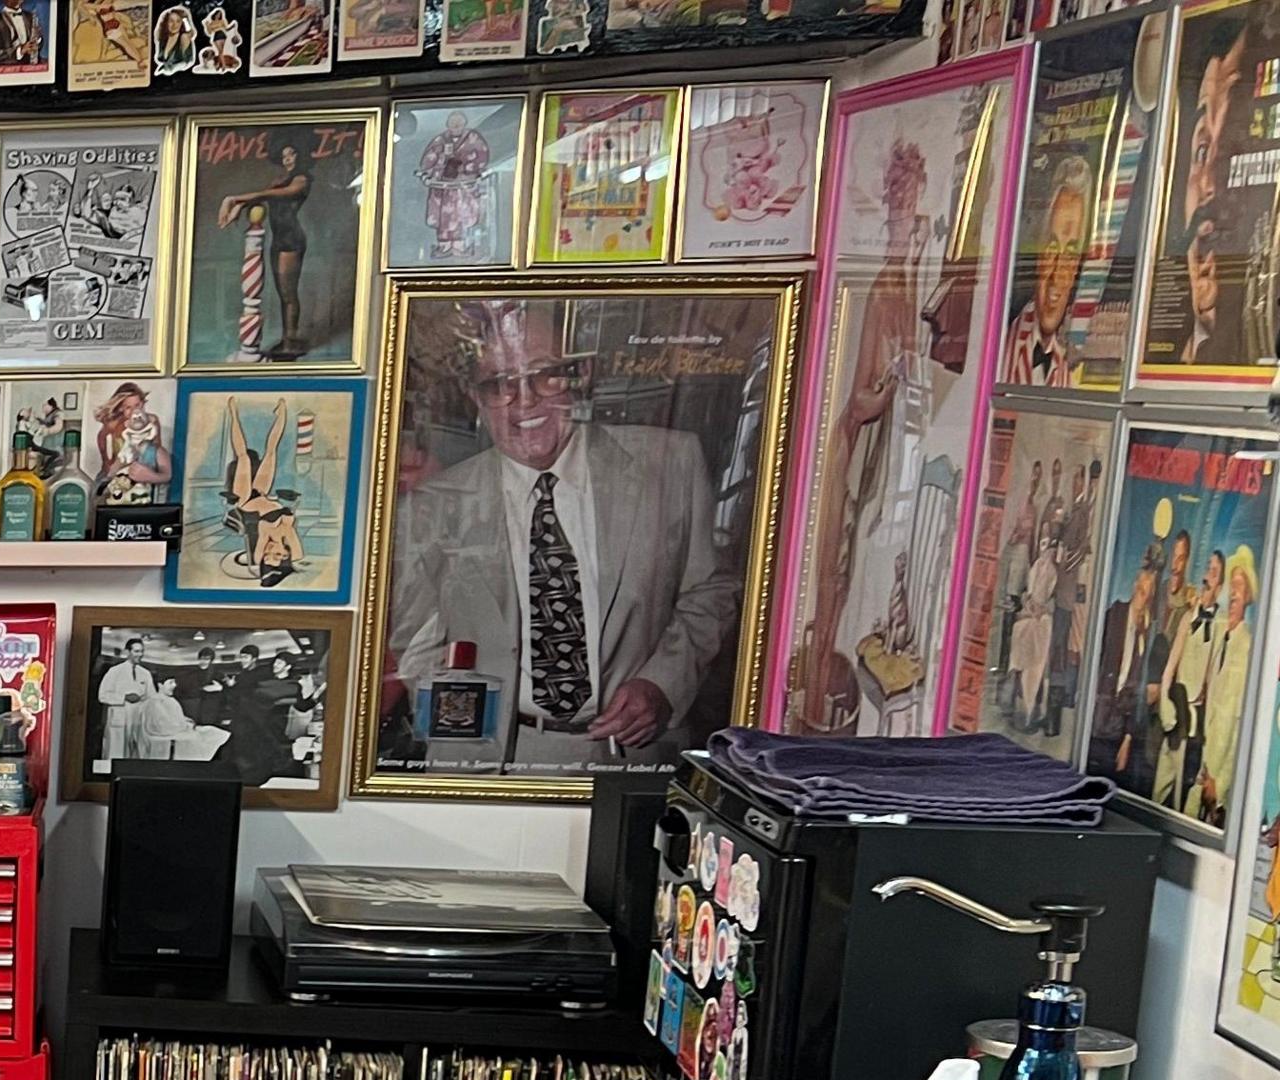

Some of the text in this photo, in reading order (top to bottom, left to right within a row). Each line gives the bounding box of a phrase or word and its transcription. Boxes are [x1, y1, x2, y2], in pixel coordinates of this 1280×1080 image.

[199, 128, 365, 165] HAVE IT!
[7, 149, 159, 169] Shaving Oddities
[764, 237, 790, 247] DEAD
[53, 323, 105, 340] GEM
[628, 334, 723, 346] Eau de toilette by
[376, 757, 404, 768] Some
[406, 759, 430, 770] guys
[432, 759, 458, 768] have
[473, 760, 502, 770] Some
[503, 761, 529, 772] guys
[626, 763, 656, 773] Label
